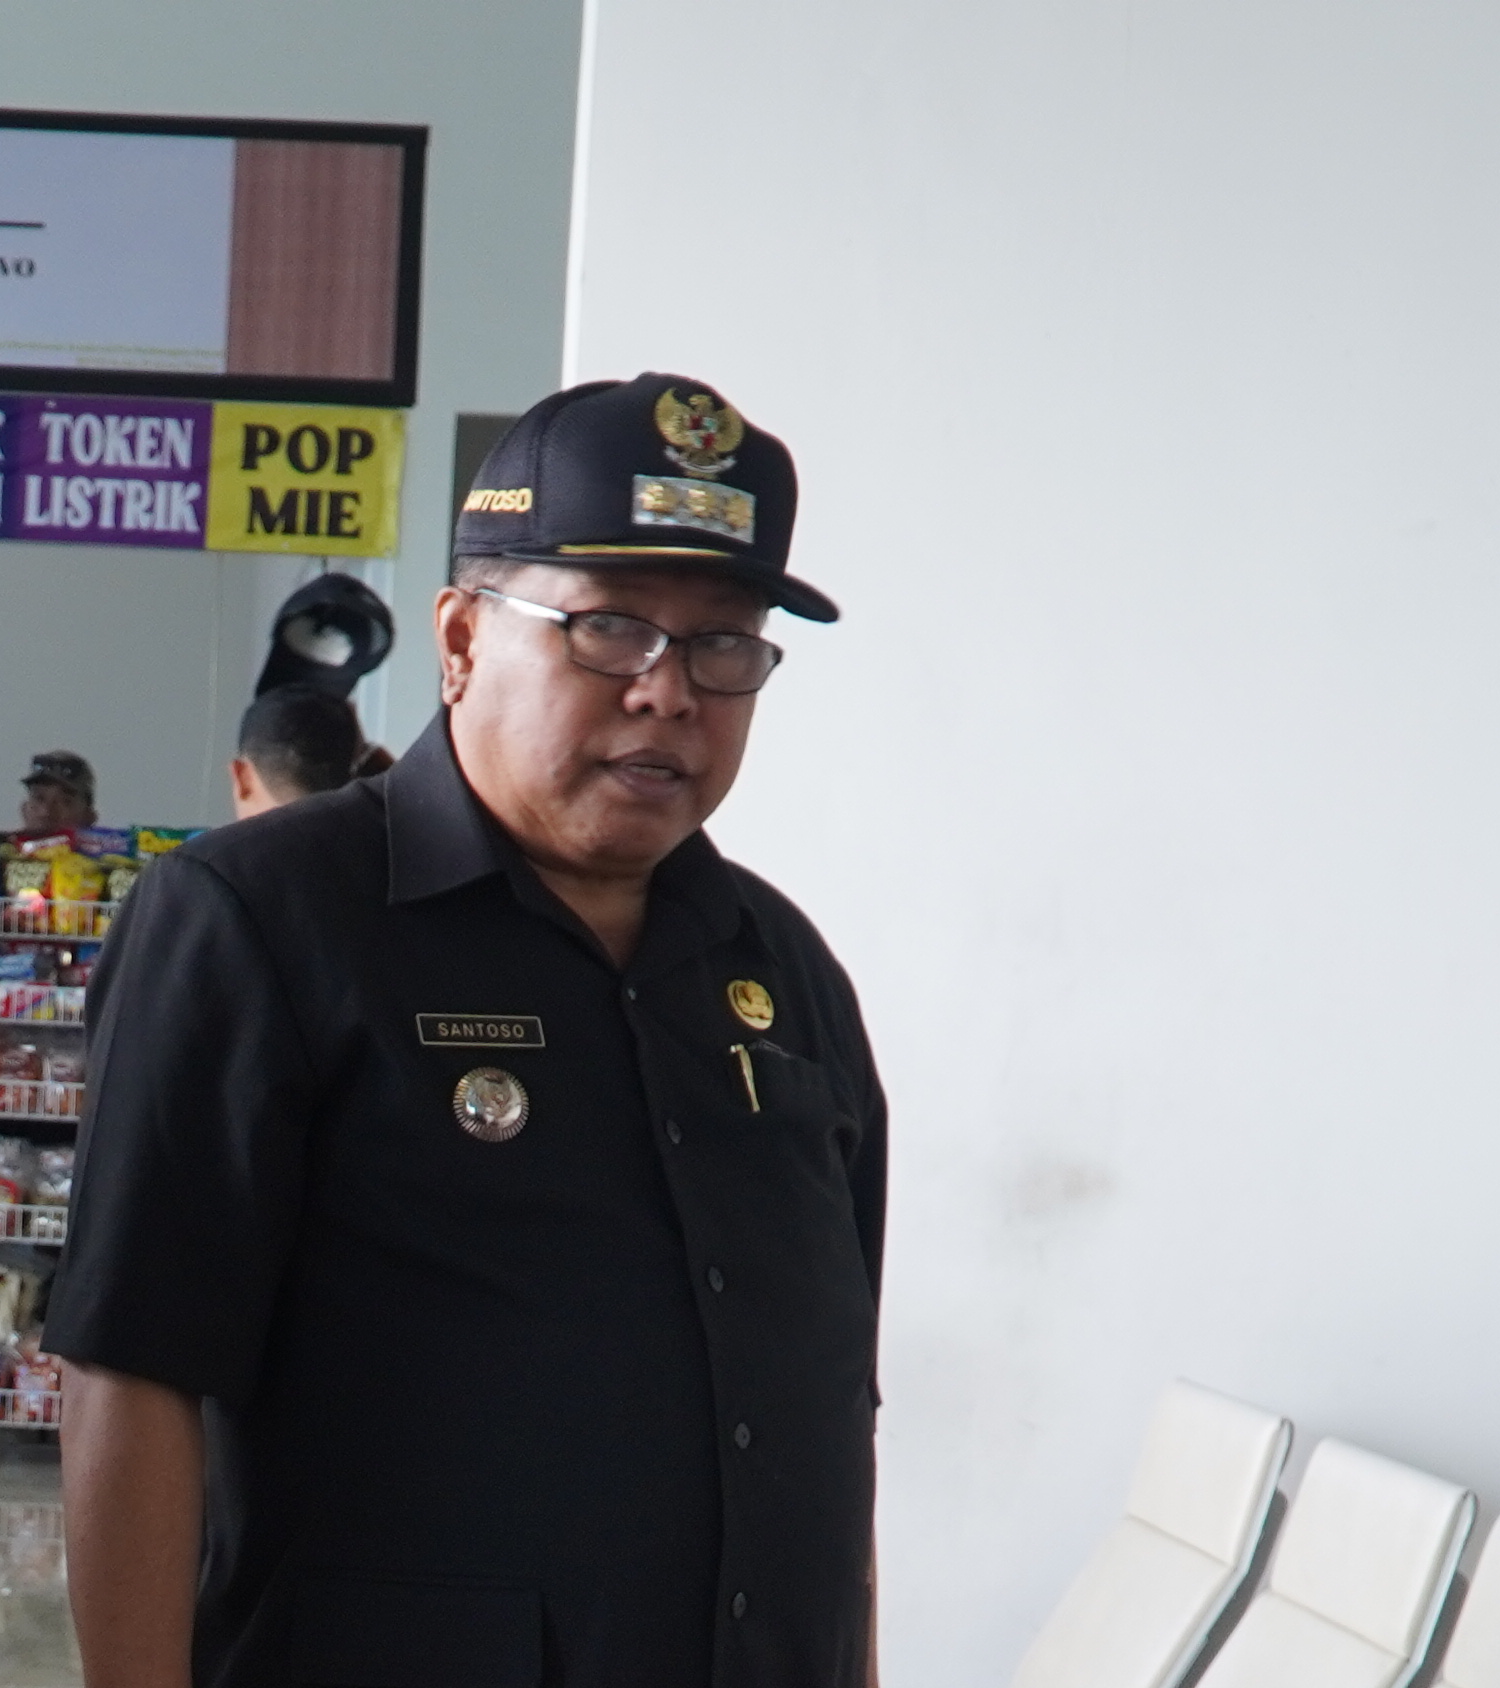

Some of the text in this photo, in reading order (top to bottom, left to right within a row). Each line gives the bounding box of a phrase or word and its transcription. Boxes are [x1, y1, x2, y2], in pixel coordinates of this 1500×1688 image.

[40, 411, 195, 470] TOKEN
[240, 423, 375, 475] POP
[22, 475, 203, 532] LISTRIK
[246, 486, 364, 539] MIE
[436, 1021, 526, 1039] SANTOSO
